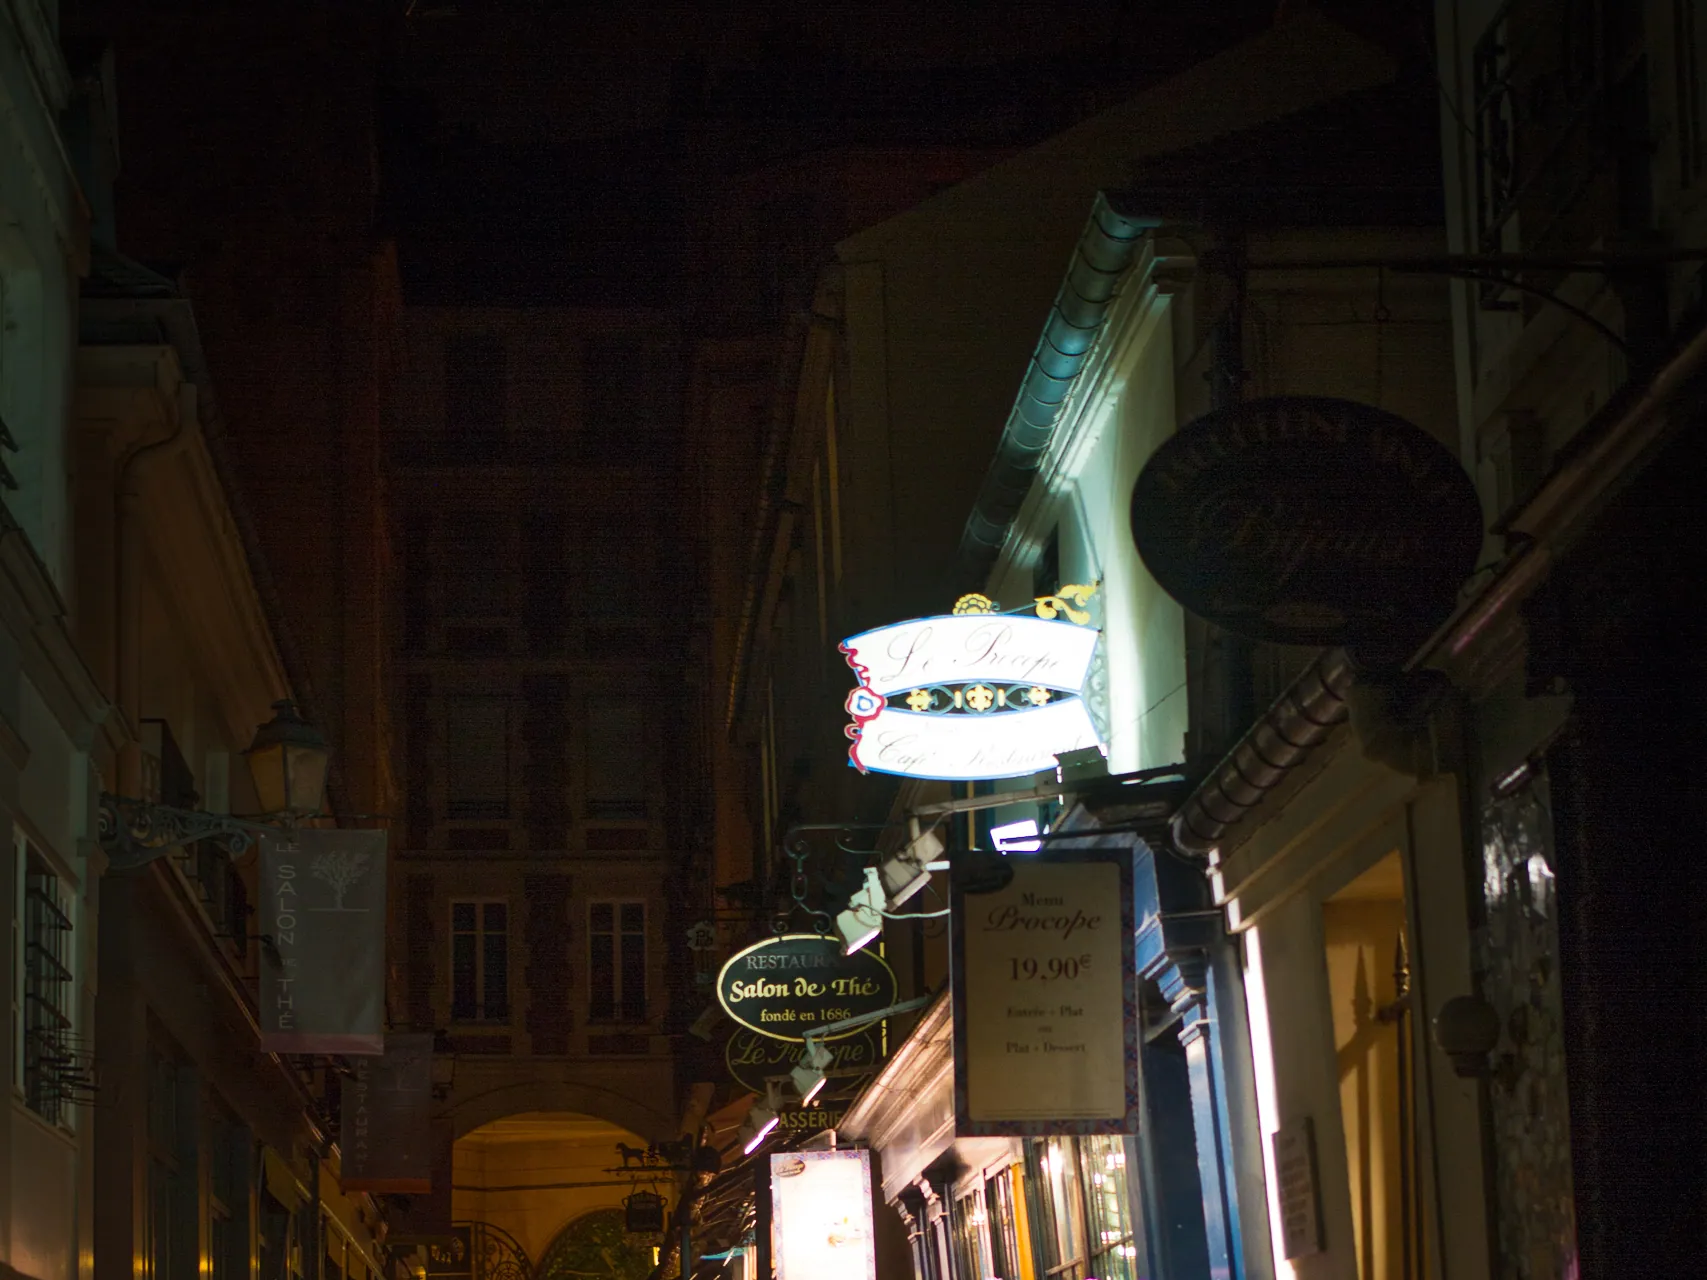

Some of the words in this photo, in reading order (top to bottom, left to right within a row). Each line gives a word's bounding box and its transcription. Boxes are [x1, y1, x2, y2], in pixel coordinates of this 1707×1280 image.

[880, 626, 933, 682] Le
[276, 865, 297, 946] SALON
[1022, 892, 1064, 906] Menu
[983, 905, 1101, 940] Procope
[729, 977, 790, 1003] Salon
[794, 977, 827, 997] de
[831, 976, 881, 997] Thé
[760, 1008, 796, 1022] fondé
[800, 1010, 816, 1021] en
[820, 1008, 852, 1021] 1686
[731, 1034, 766, 1066] Le
[777, 1110, 842, 1130] ASSERIE
